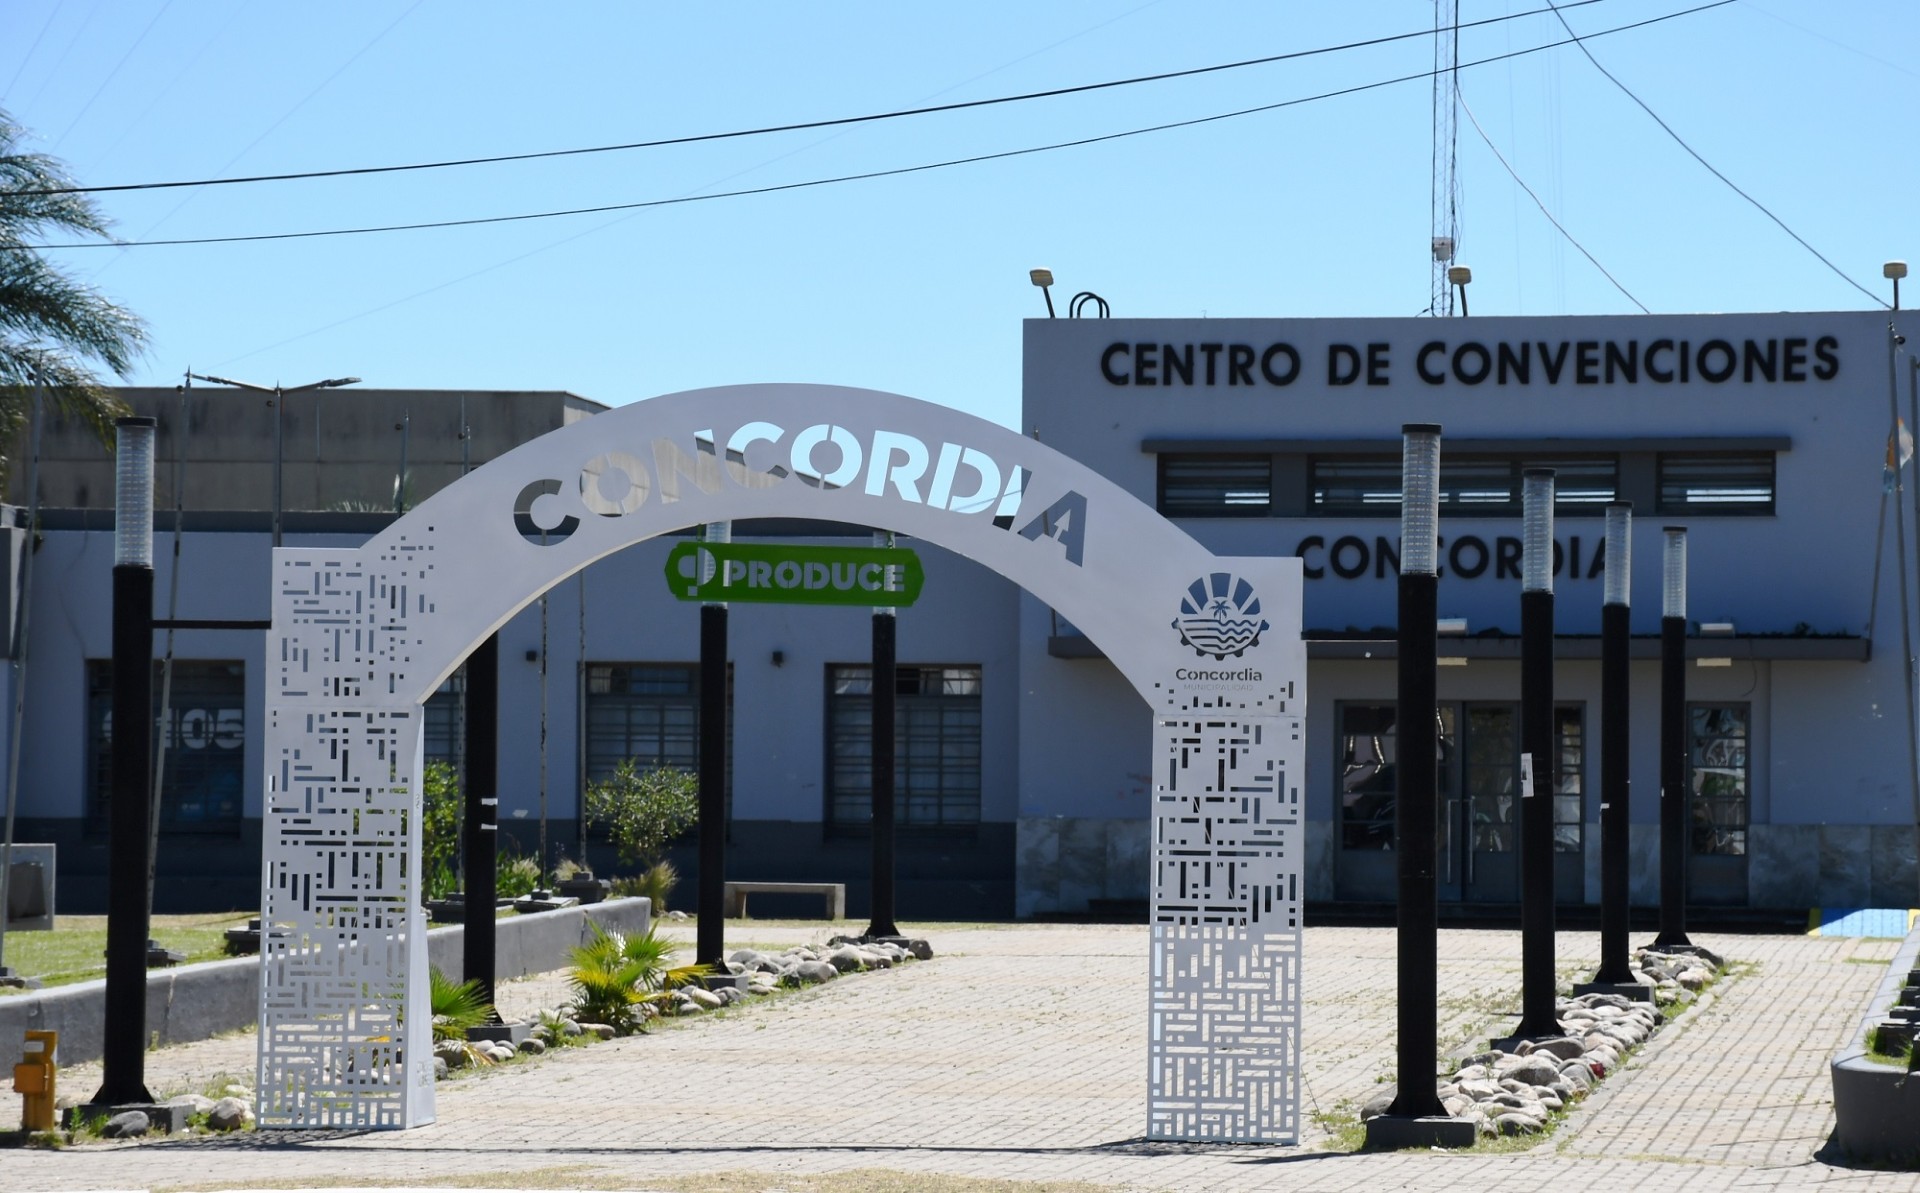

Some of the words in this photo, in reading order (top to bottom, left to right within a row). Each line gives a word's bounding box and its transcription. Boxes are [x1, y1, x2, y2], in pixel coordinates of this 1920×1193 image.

[1101, 341, 1302, 387] CENTRO
[1328, 343, 1390, 387] DE
[1415, 336, 1840, 386] CONVENCIONES
[513, 421, 1089, 567] CONCORDIA
[723, 559, 905, 592] PRODUCE
[1295, 535, 1606, 580] CONORI
[1175, 668, 1262, 681] Concordia
